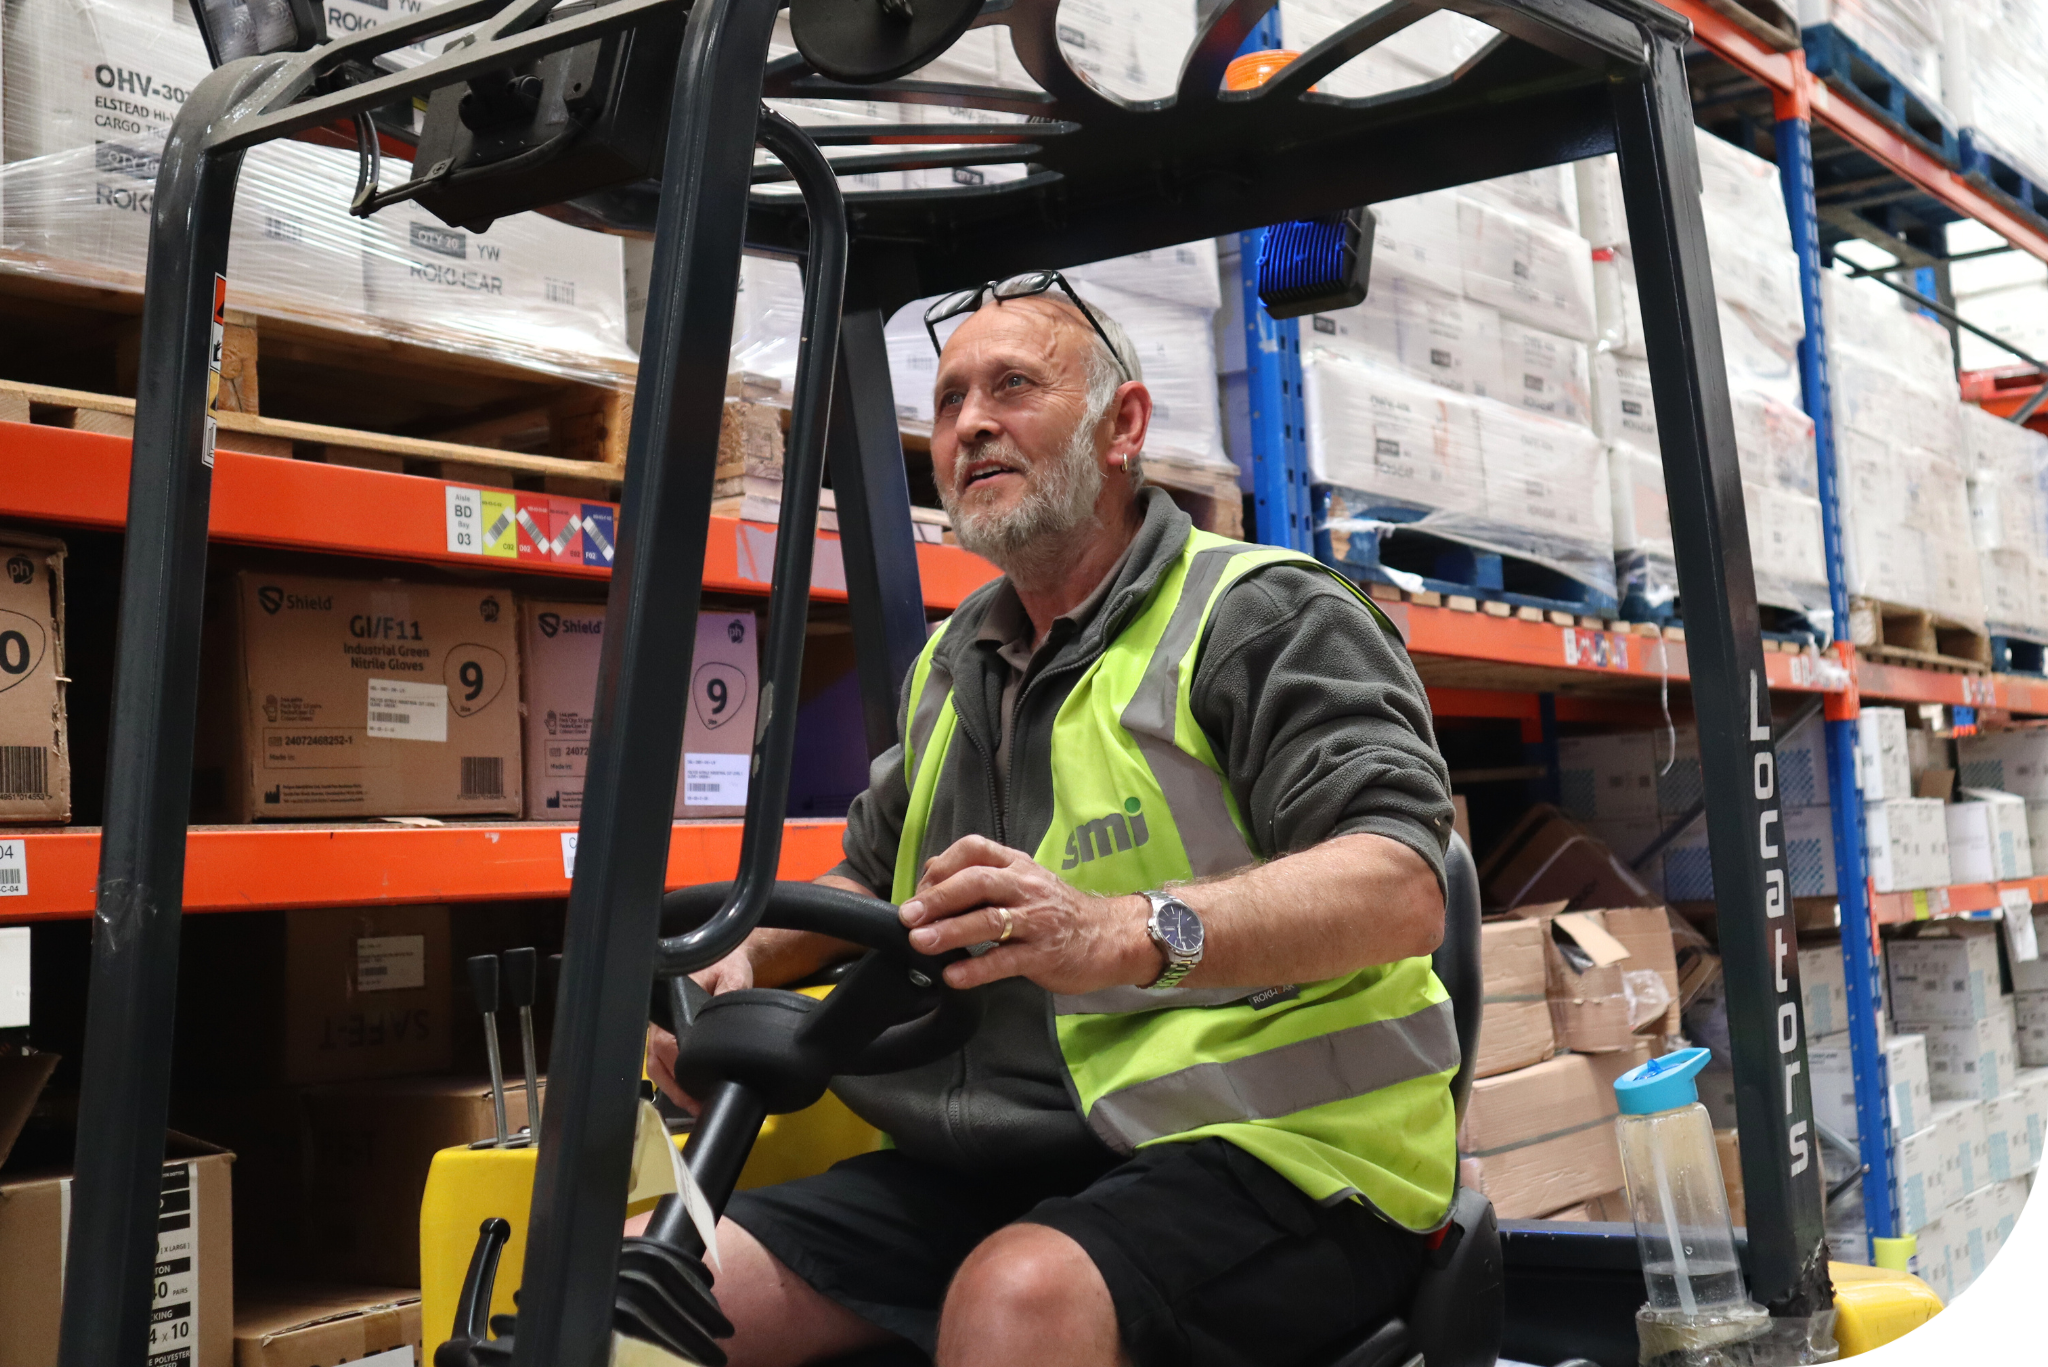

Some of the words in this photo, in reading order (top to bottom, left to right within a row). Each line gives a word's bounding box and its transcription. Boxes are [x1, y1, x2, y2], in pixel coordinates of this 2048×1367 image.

[95, 96, 149, 118] ELSTEAD
[95, 114, 141, 134] CARGO
[96, 183, 153, 213] ROK
[418, 231, 442, 246] QTY
[445, 235, 459, 249] 20
[477, 244, 500, 261] YW
[455, 494, 471, 502] Aisle
[455, 505, 472, 518] BD
[458, 521, 470, 529] Bay
[457, 533, 471, 545] 03
[503, 543, 514, 551] C02
[585, 551, 596, 560] F02
[286, 594, 332, 610] Shield
[562, 620, 602, 634] Shield
[344, 642, 395, 656] Industrial
[398, 645, 429, 658] Green
[351, 656, 385, 670] Nitrile
[388, 658, 424, 671] Gloves
[459, 661, 484, 701] 9
[706, 678, 728, 715] 9
[1061, 796, 1150, 871] smi
[1749, 668, 1809, 1178] Locators
[1252, 984, 1295, 1004] ROKWAR
[173, 1287, 188, 1296] PAIRS
[151, 1309, 173, 1321] KING
[149, 1328, 157, 1344] 4
[171, 1321, 189, 1340] 10
[154, 1350, 190, 1365] POLYESTER
